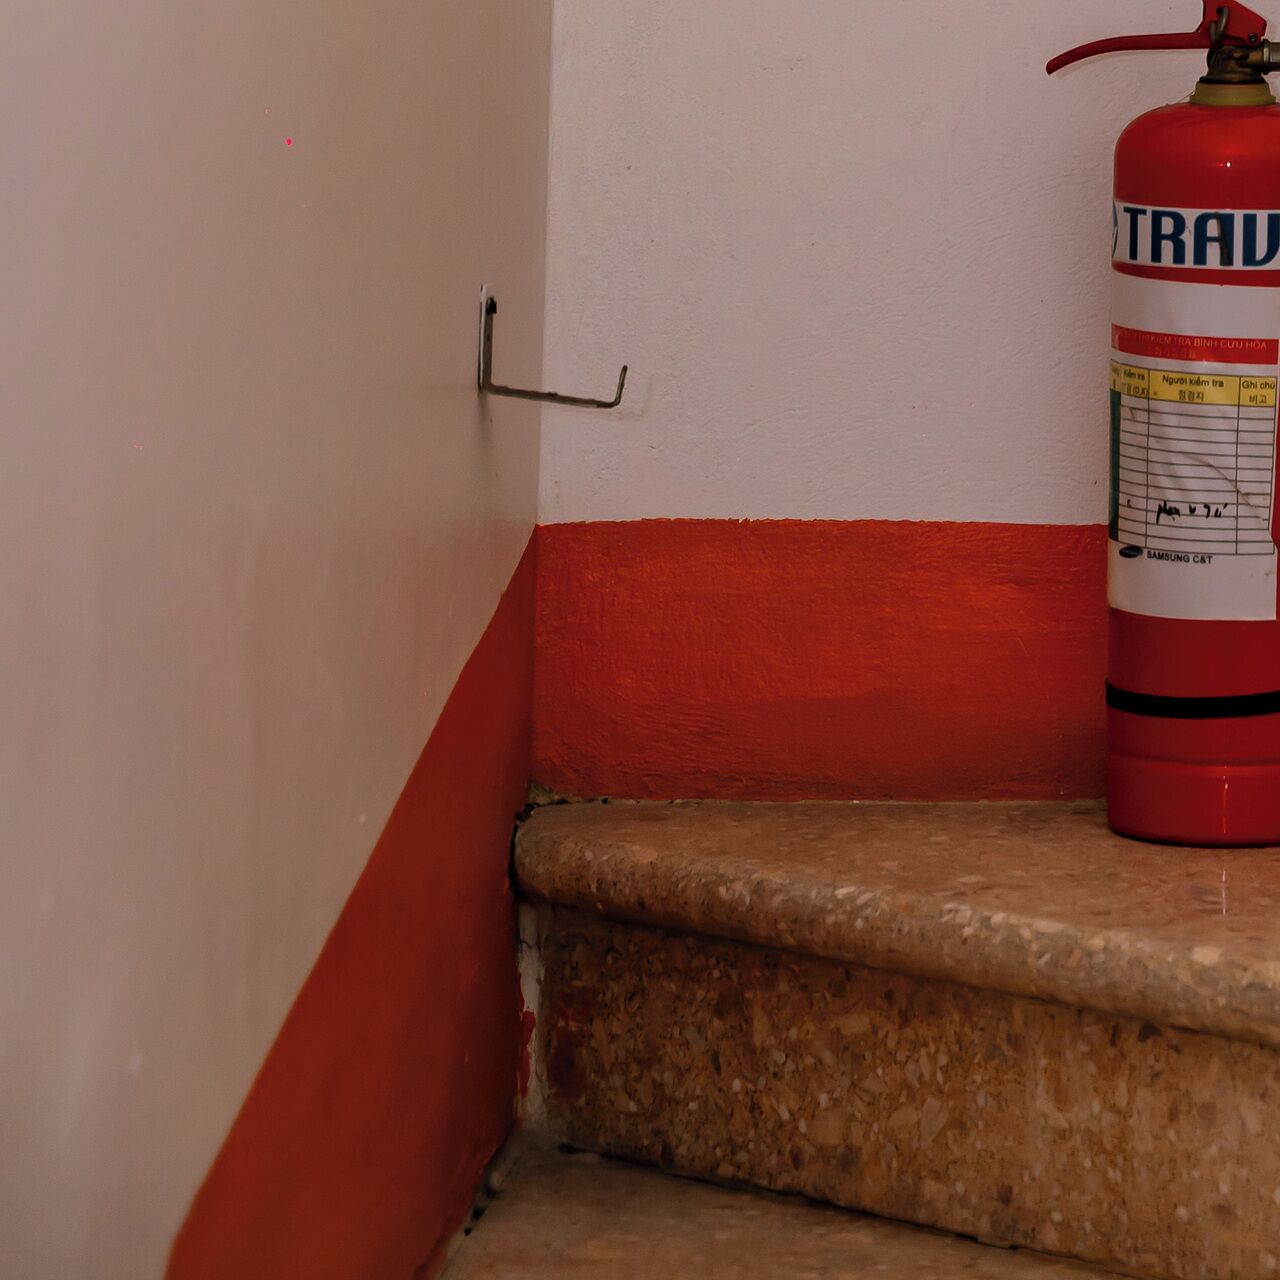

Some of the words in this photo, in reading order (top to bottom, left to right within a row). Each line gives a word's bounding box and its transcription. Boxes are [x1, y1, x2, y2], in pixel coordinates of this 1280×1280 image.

[1212, 378, 1224, 387] tra
[1241, 380, 1257, 389] Ghi
[1147, 550, 1190, 563] SAMSUNG
[1192, 555, 1213, 564] C&T
